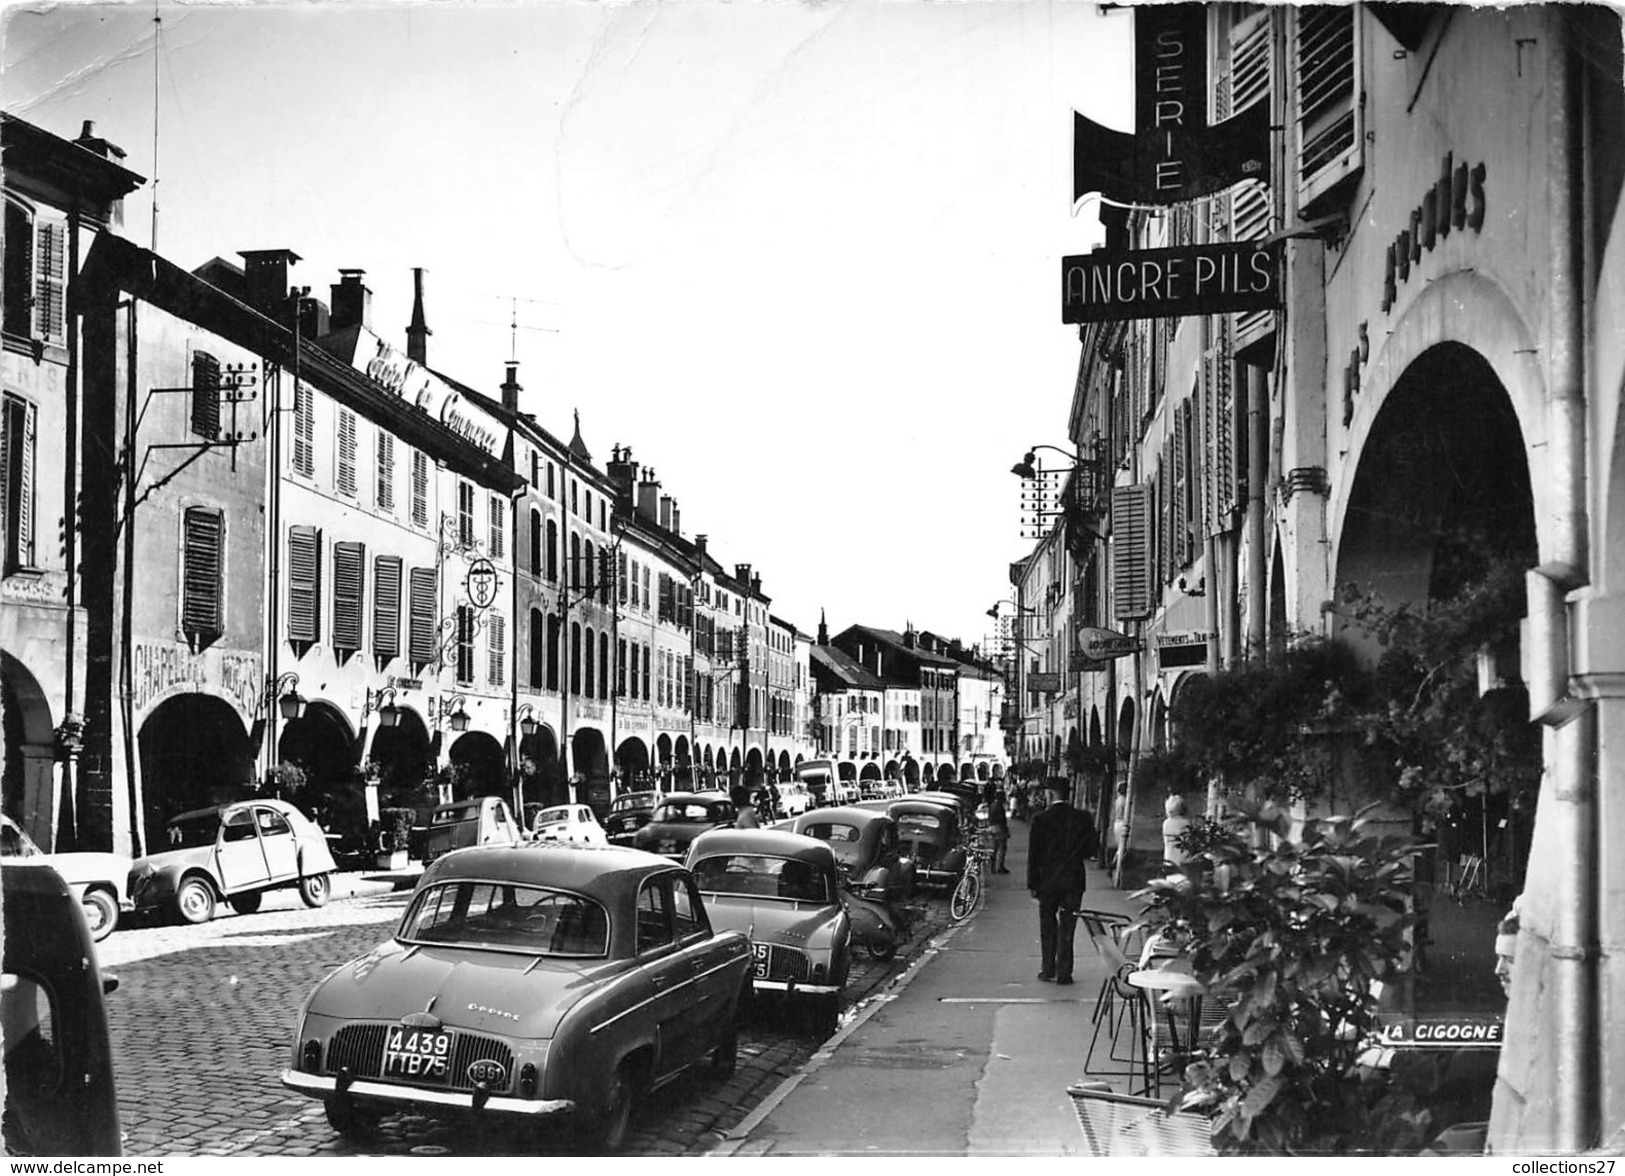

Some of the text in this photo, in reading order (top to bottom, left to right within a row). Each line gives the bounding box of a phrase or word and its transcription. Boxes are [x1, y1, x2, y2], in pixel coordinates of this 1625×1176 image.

[1156, 31, 1184, 190] SERIE
[1067, 250, 1271, 305] ANCRE PILS
[754, 963, 766, 977] 5
[389, 1031, 449, 1055] 4439
[1415, 1024, 1499, 1039] CIGOGNE
